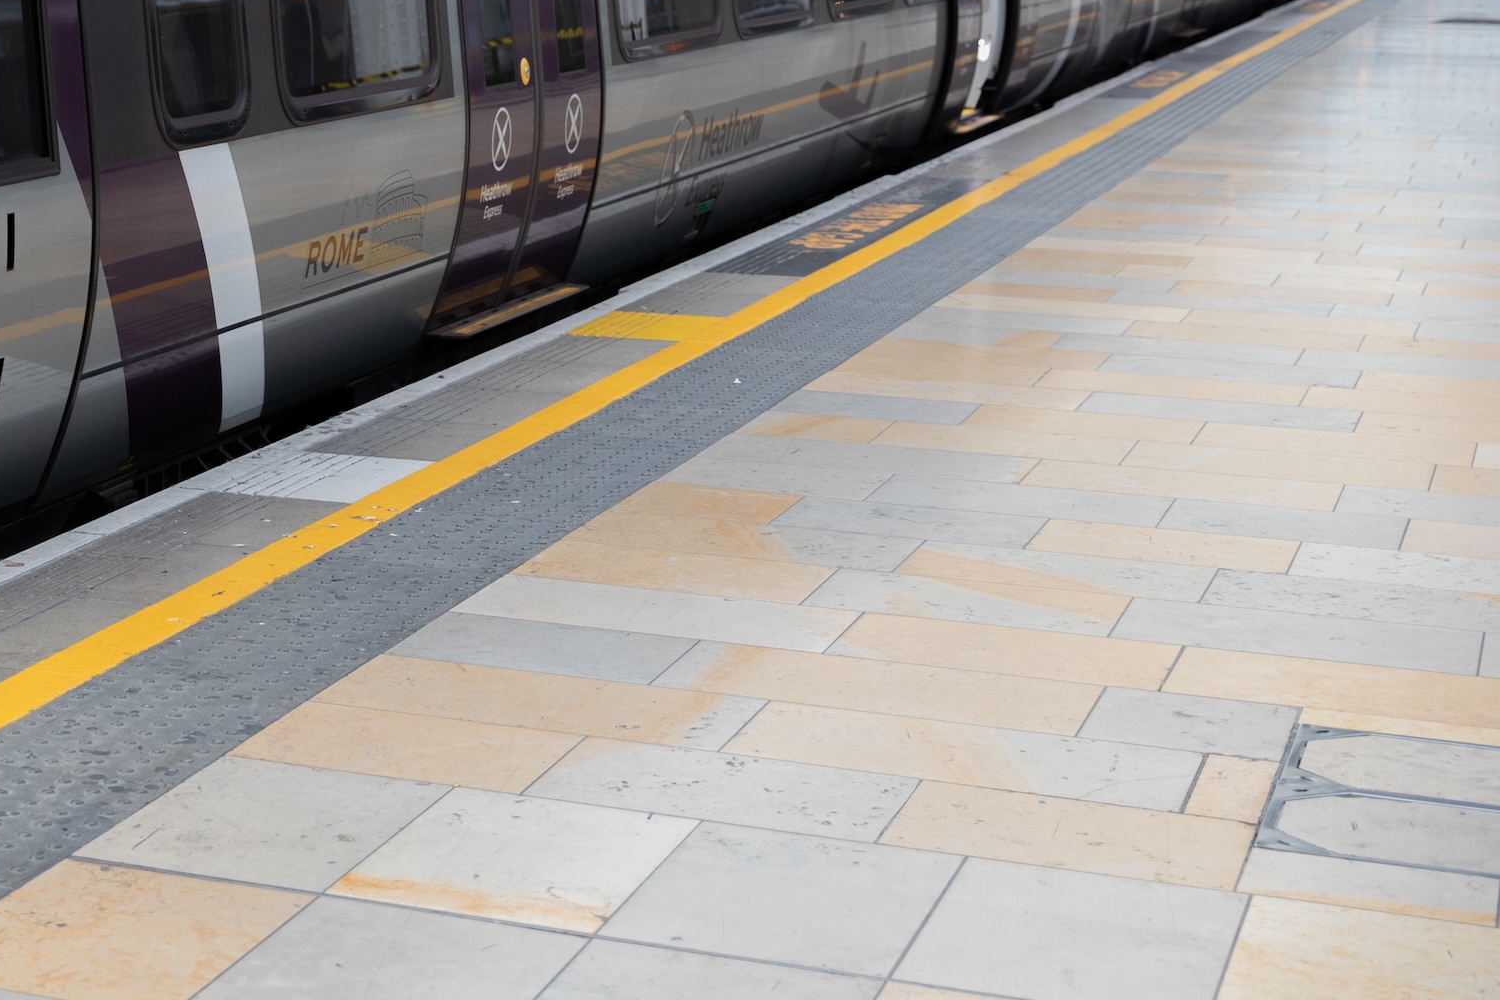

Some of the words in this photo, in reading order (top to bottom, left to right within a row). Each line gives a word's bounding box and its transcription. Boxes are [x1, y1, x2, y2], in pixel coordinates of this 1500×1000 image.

[697, 108, 765, 161] Heathrow
[554, 162, 584, 183] Heathrow
[479, 181, 513, 203] Heathrow
[557, 184, 575, 200] Express
[483, 205, 504, 221] Express
[304, 226, 369, 279] ROME
